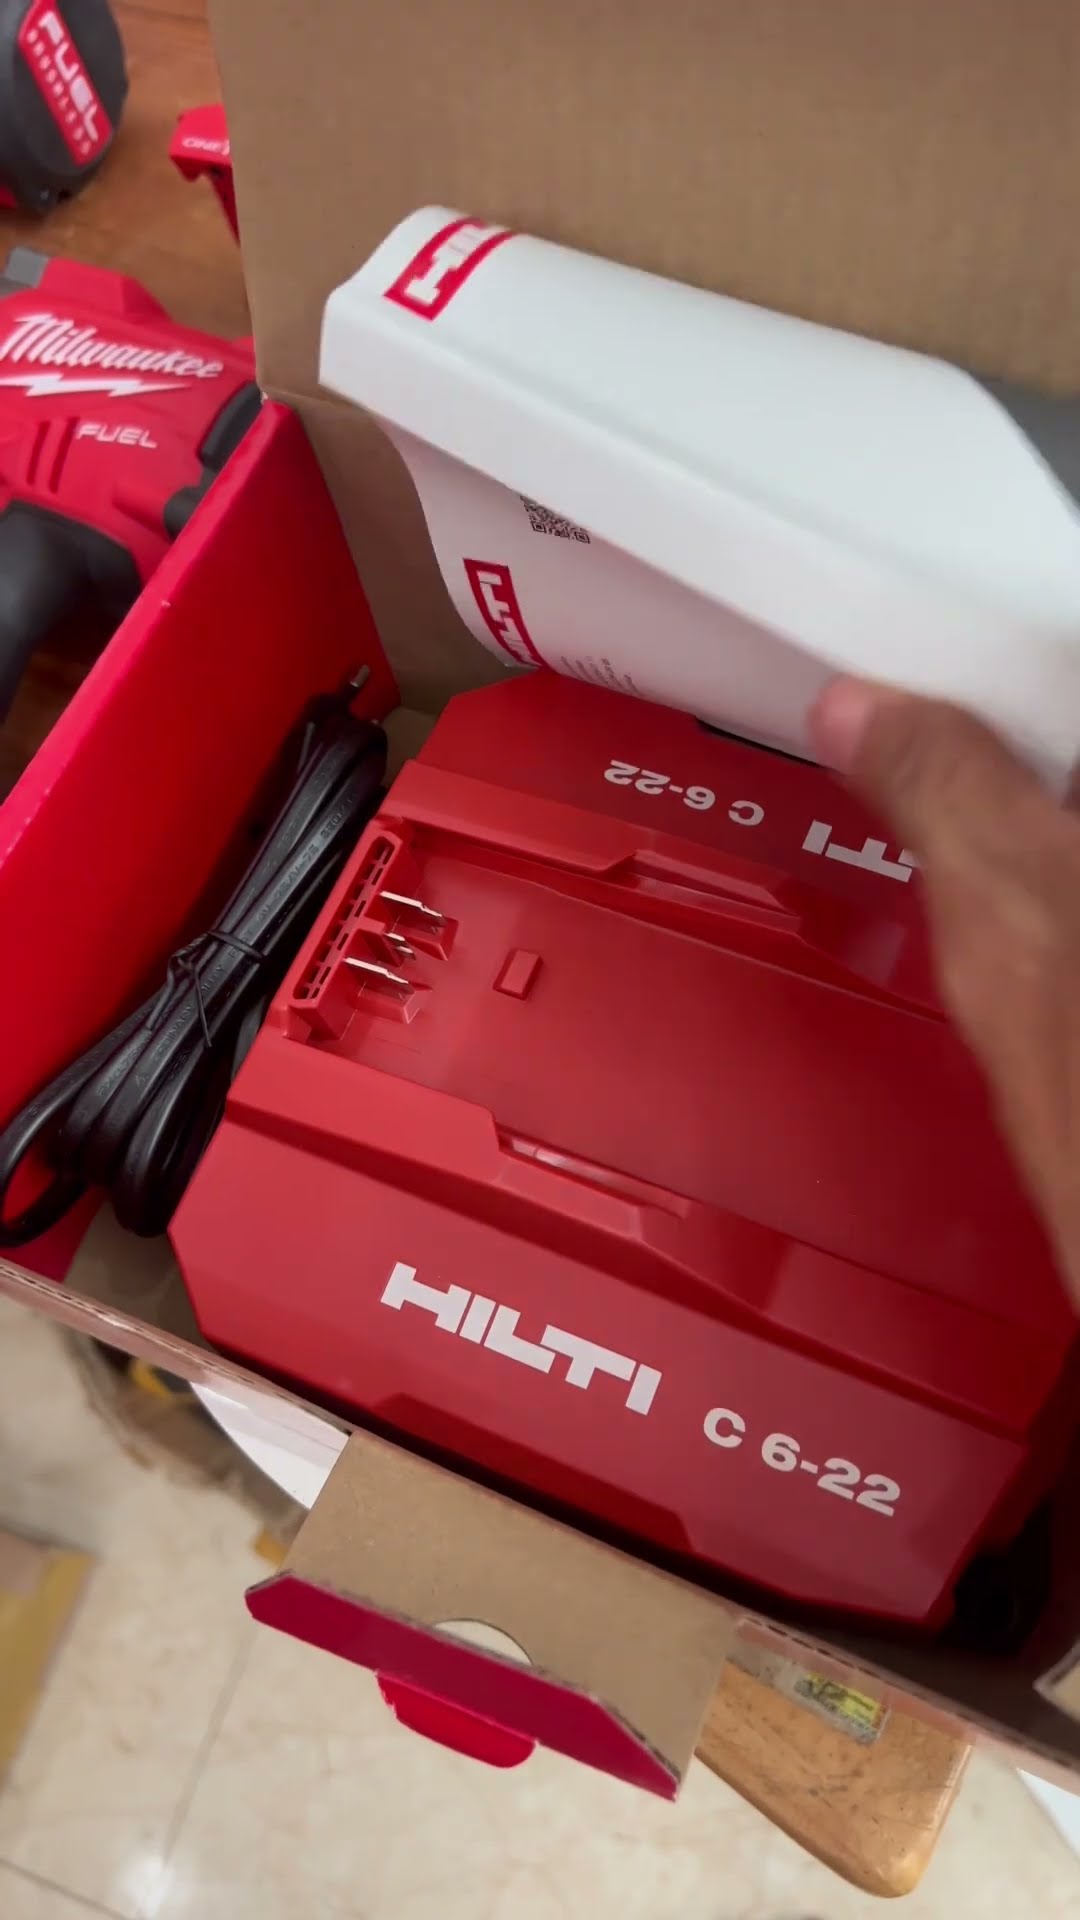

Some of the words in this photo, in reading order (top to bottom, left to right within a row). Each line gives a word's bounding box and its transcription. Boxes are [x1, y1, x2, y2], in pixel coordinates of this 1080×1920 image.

[38, 11, 99, 142] FUEL
[0, 313, 224, 378] Milwaukee
[75, 423, 157, 449] FUEL
[604, 760, 716, 811] 6-22
[728, 800, 765, 826] C
[380, 1261, 662, 1416] HILTI
[703, 1407, 746, 1448] C
[760, 1432, 901, 1517] 6-22
